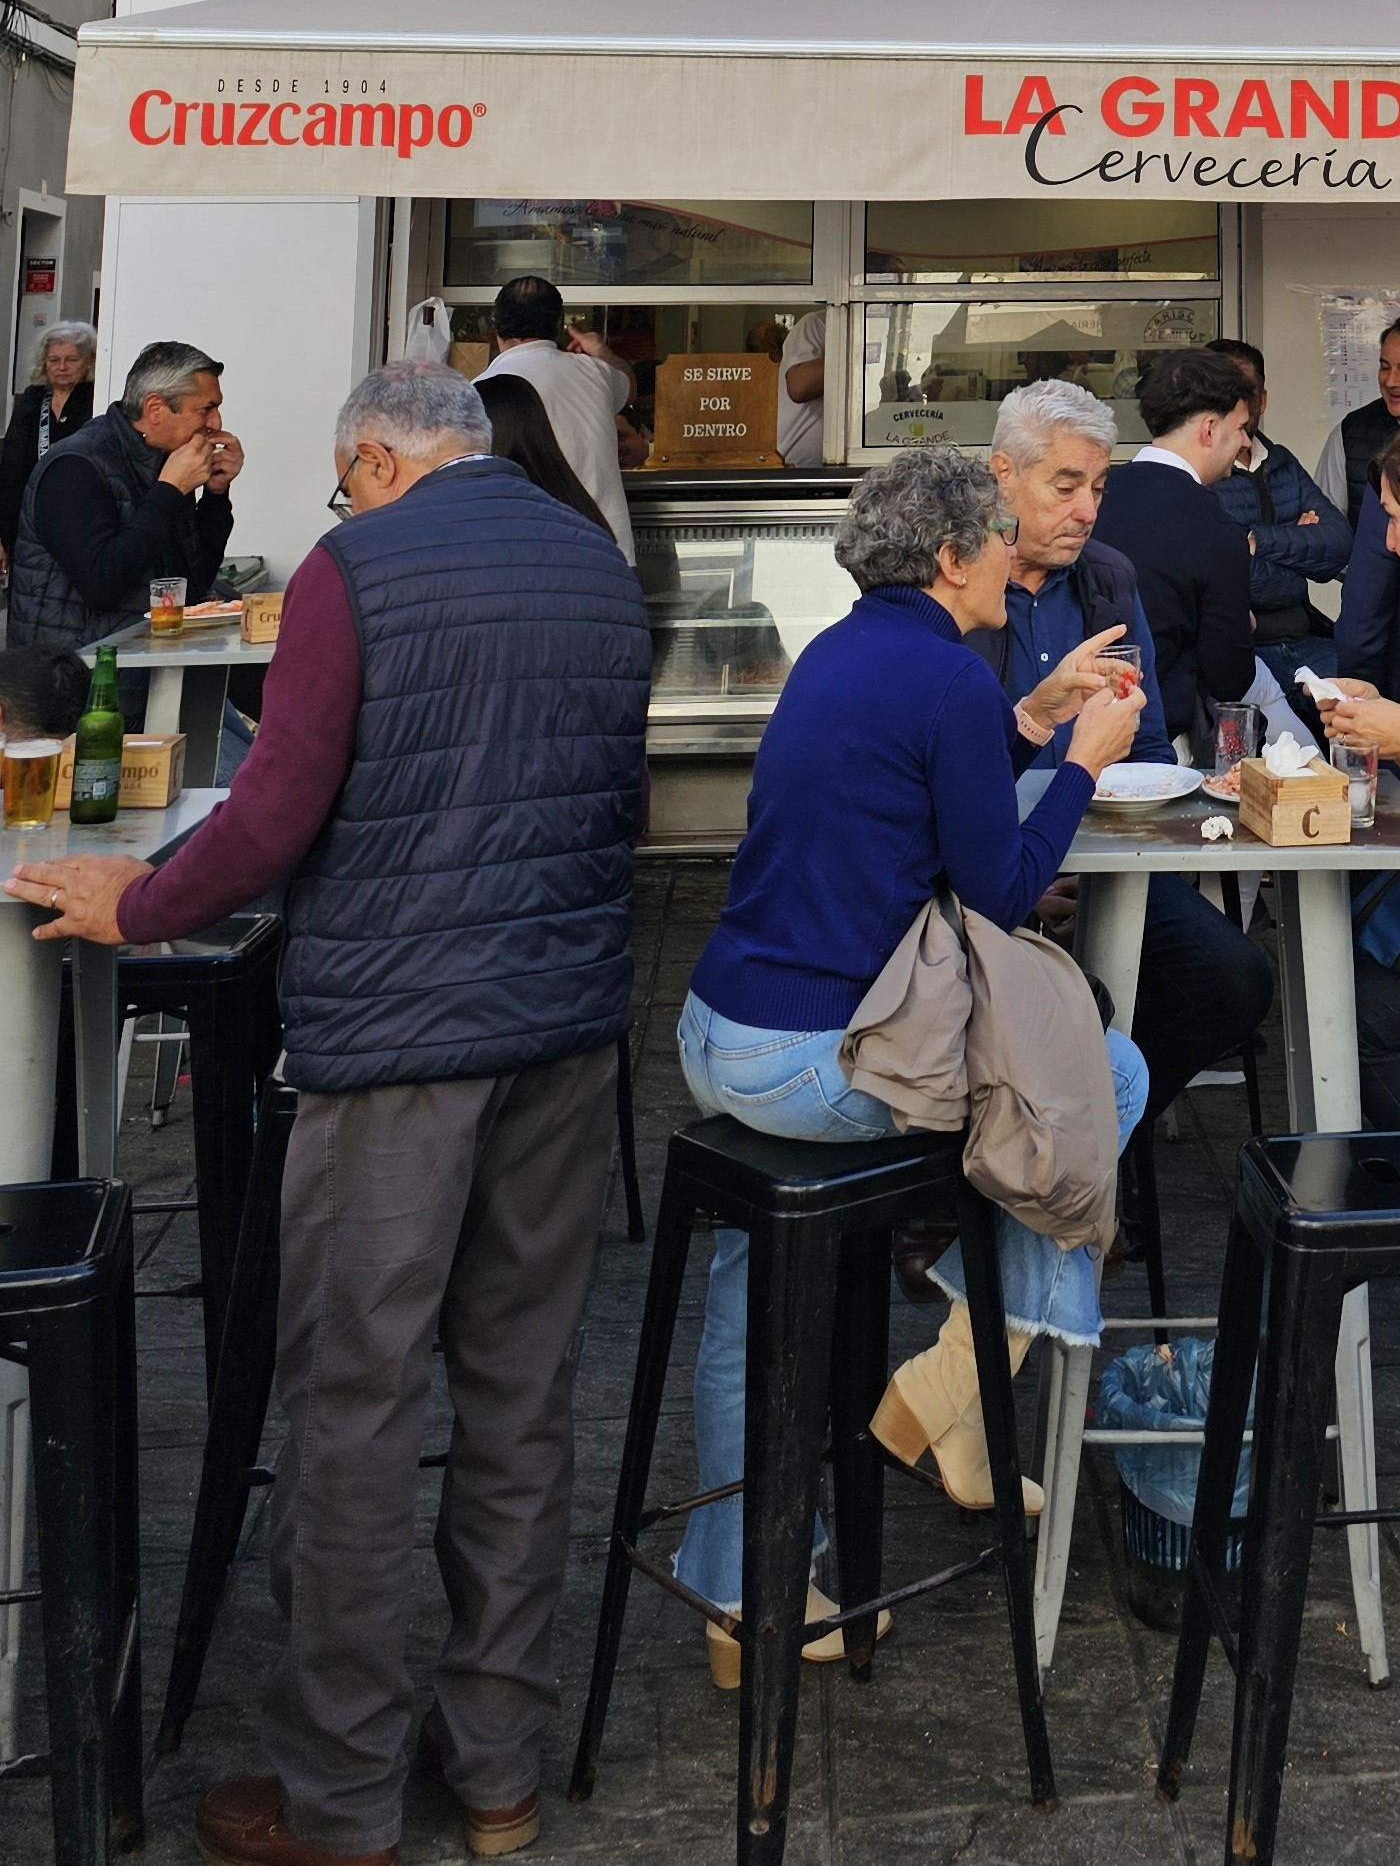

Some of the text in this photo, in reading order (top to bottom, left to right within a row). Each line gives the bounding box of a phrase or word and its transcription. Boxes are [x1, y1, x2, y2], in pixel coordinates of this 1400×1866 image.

[217, 78, 388, 94] DESDE 1904
[964, 74, 1066, 136] LA
[1024, 104, 1392, 190] Cervecería
[683, 367, 752, 382] SE SIRVE
[699, 397, 731, 411] POR
[892, 408, 944, 422] CERVECERÍA
[682, 422, 747, 438] DENTRO
[885, 431, 900, 444] LA
[1301, 805, 1321, 839] C
